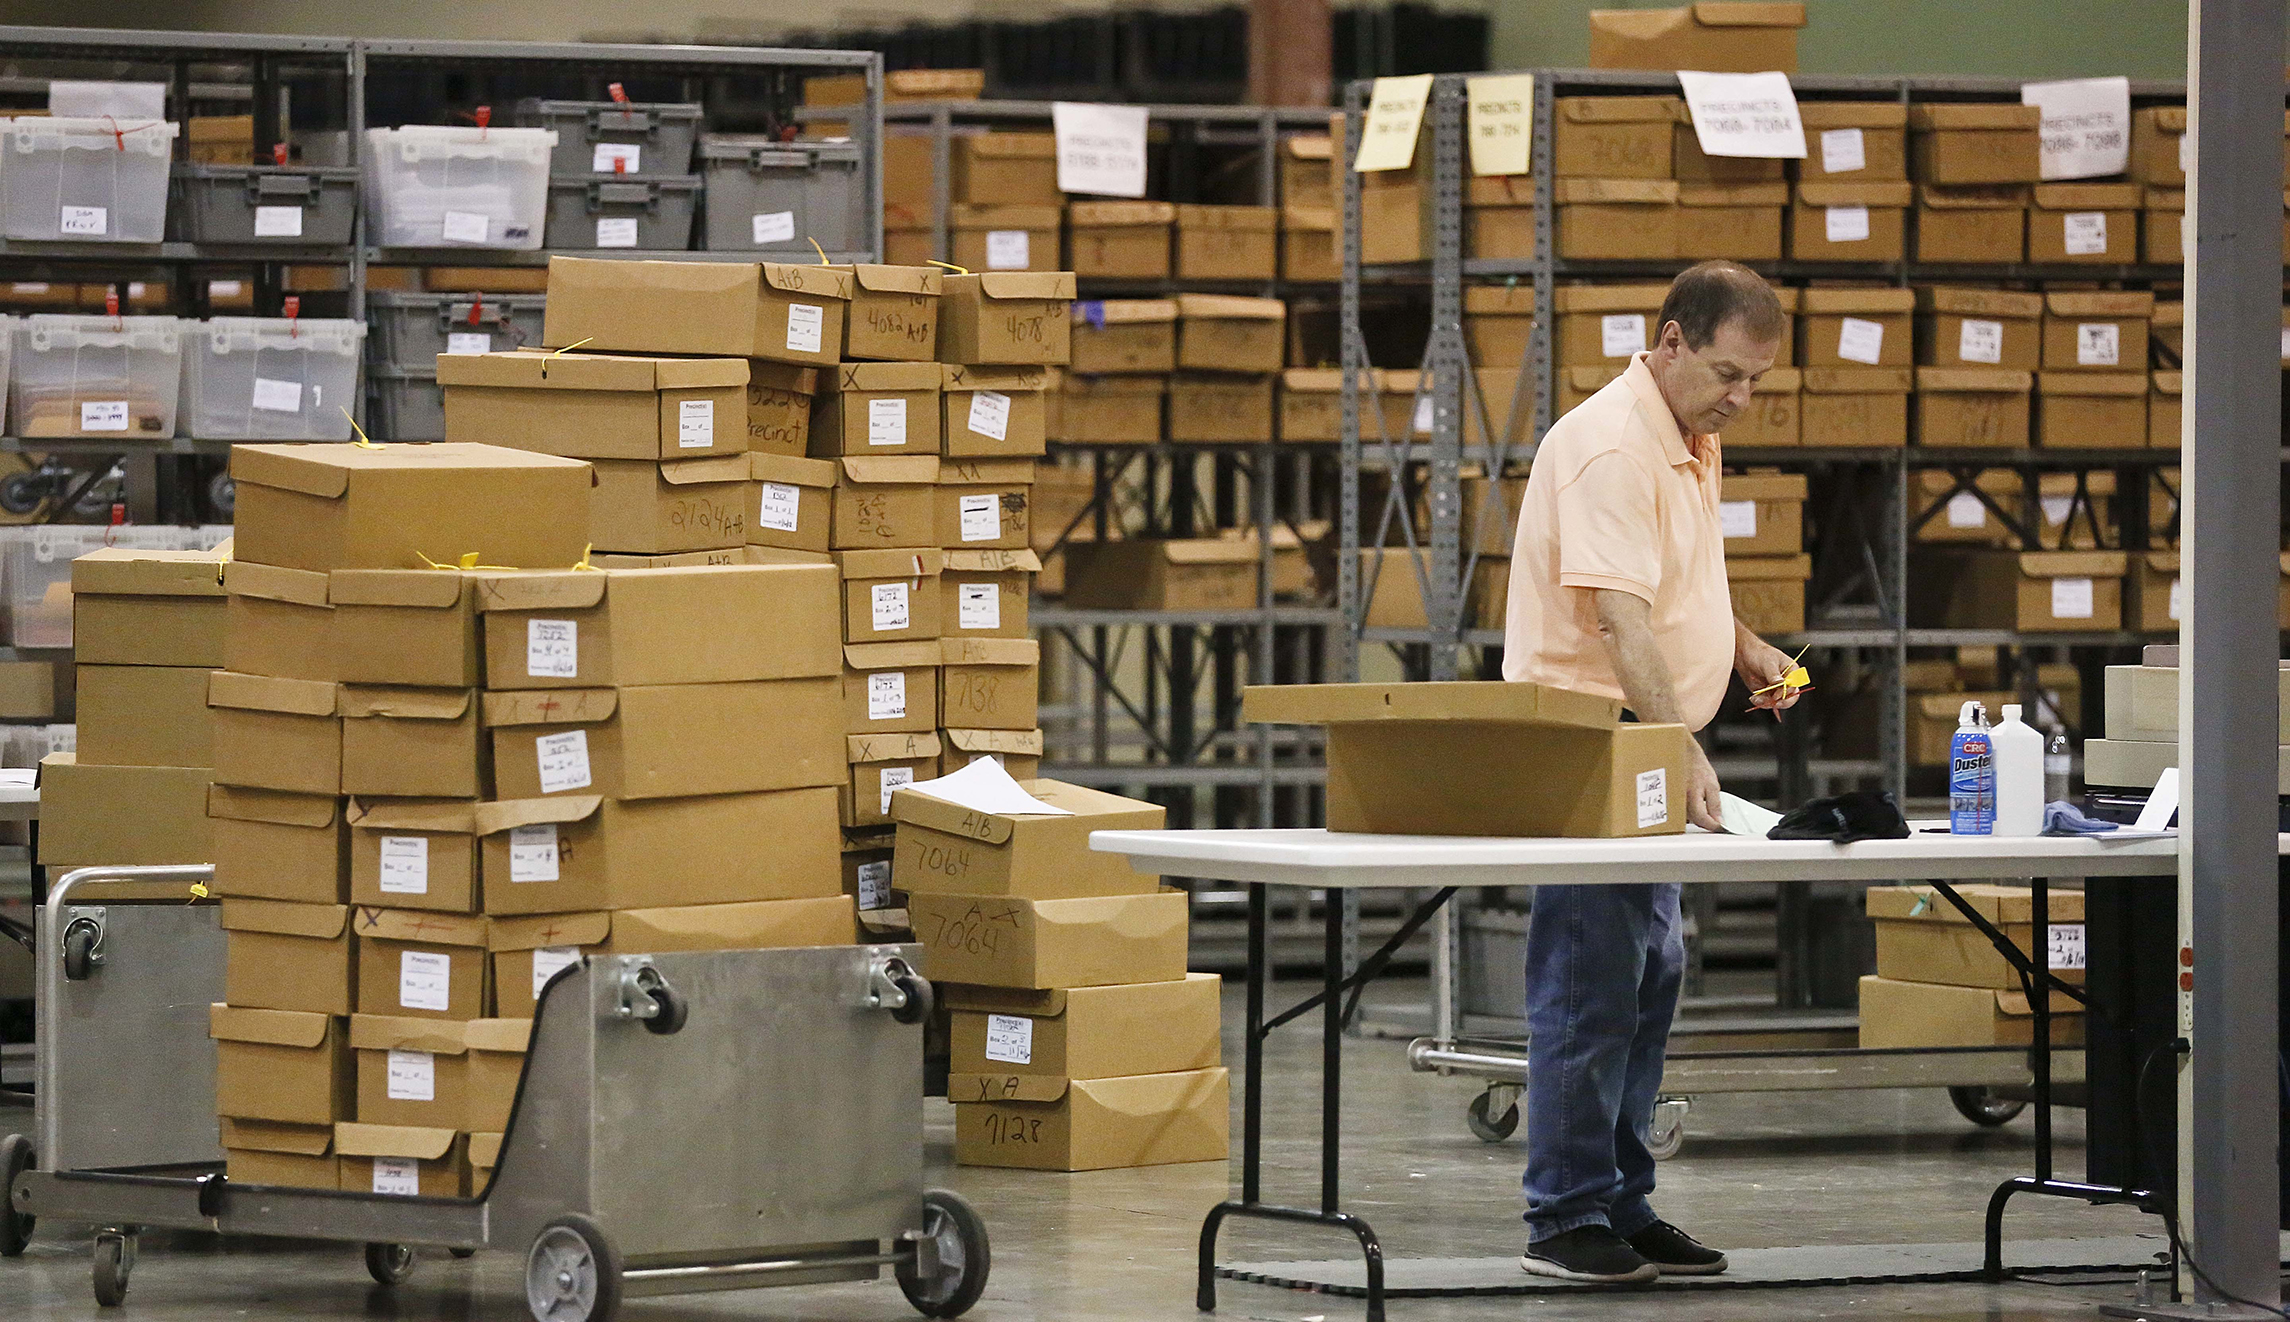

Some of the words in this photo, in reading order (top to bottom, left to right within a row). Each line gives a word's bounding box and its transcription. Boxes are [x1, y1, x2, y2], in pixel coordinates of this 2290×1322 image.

[868, 306, 904, 334] 4082
[1006, 314, 1043, 343] 4078
[843, 364, 861, 391] X
[951, 370, 965, 387] X
[671, 498, 725, 533] 2124
[858, 740, 874, 763] X
[906, 735, 917, 758] A
[1964, 744, 1986, 752] CRC
[1955, 755, 1992, 771] Duster
[961, 812, 993, 838] A/B
[912, 838, 971, 878] 7064
[964, 901, 983, 923] A
[990, 907, 1021, 929] X
[930, 912, 1000, 961] 7064
[979, 1077, 992, 1103] X
[1002, 1076, 1020, 1098] A
[985, 1112, 1044, 1146] 7128
